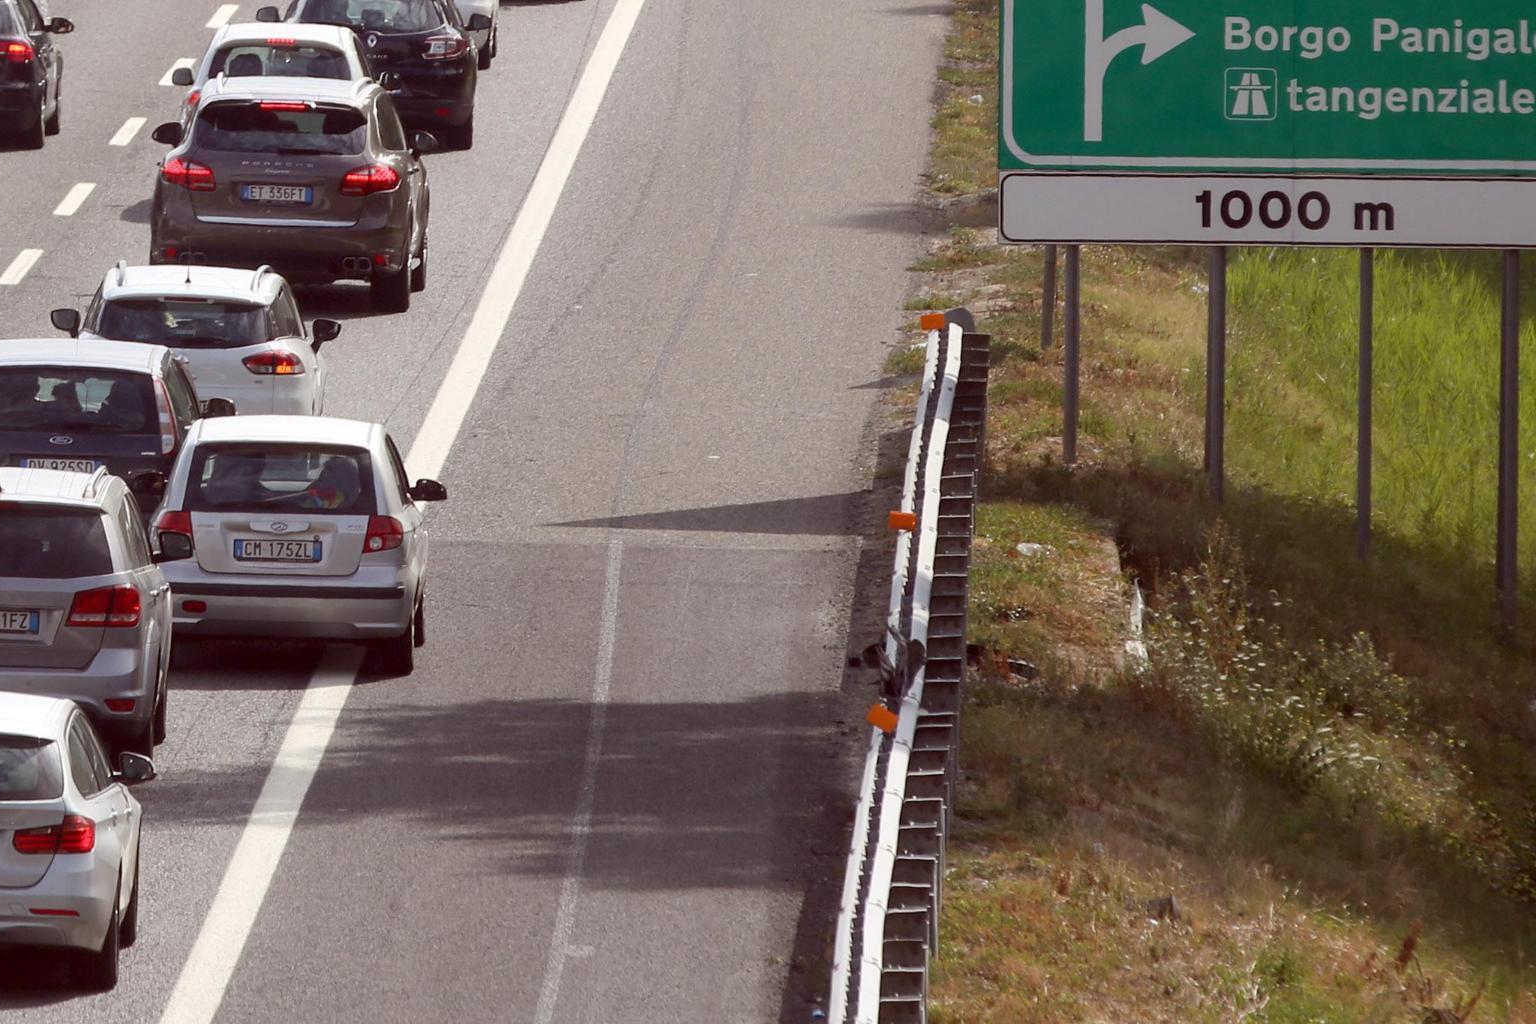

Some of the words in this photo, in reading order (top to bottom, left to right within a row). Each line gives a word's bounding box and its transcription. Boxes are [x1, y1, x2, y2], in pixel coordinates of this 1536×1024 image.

[1224, 16, 1351, 59] Borgo
[1372, 18, 1536, 61] Panigal
[1287, 79, 1536, 120] tangenziale
[250, 186, 264, 198] ET
[270, 187, 304, 200] 336FT
[1195, 190, 1331, 230] 1000
[1354, 201, 1394, 230] m
[244, 542, 262, 556] CM
[269, 543, 311, 558] 175ZL
